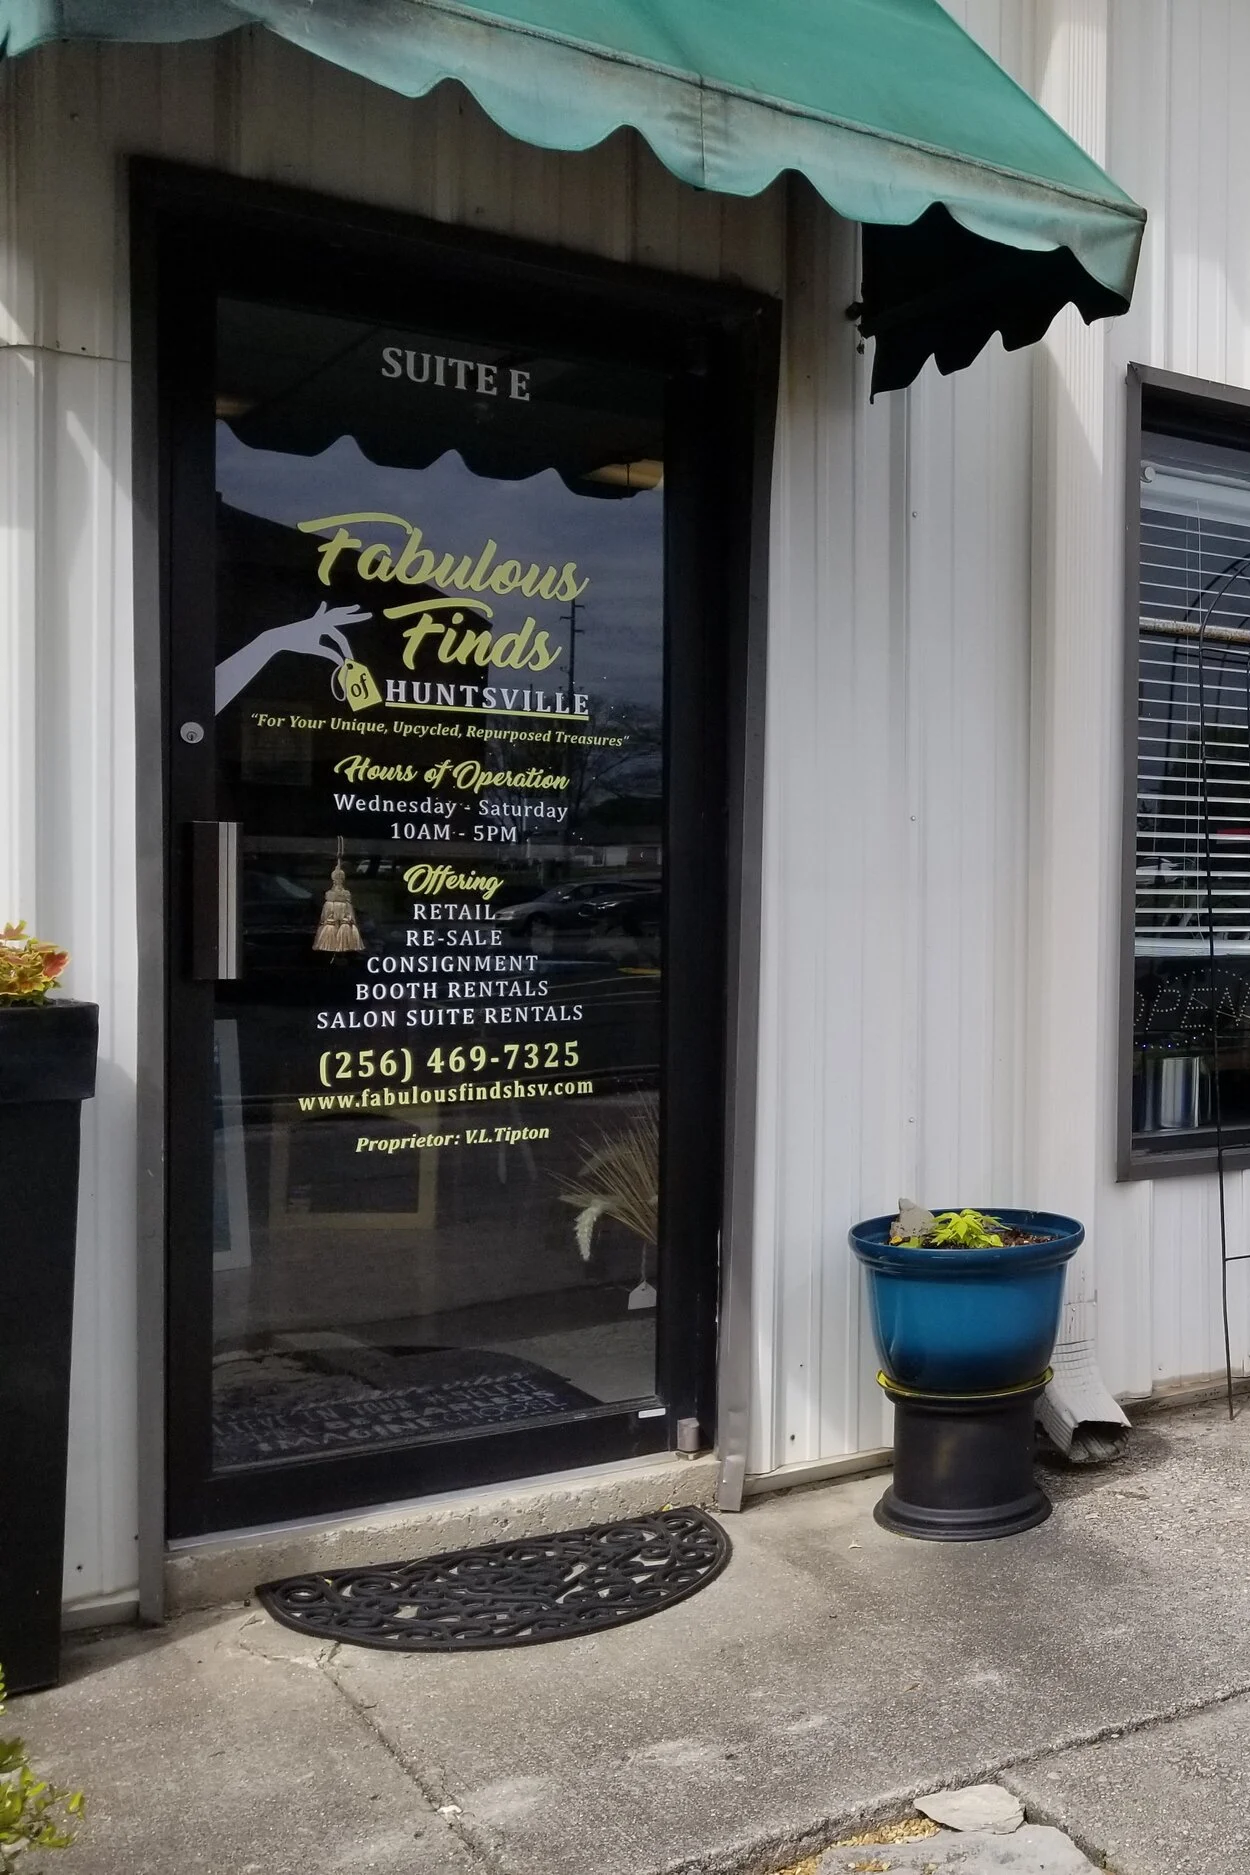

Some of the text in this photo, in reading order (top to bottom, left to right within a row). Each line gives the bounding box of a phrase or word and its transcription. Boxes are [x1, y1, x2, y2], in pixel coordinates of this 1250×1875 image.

[382, 347, 531, 401] SUITE E
[297, 512, 590, 602] Fabulous
[384, 597, 562, 672] Finds
[350, 673, 589, 715] of HUNTSVILLE
[289, 715, 326, 730] Your
[330, 717, 388, 735] Unique,
[393, 721, 462, 739] Upcycled,
[466, 725, 551, 743] Repurposed
[334, 755, 570, 794] Hours of Operation
[334, 793, 457, 818] Wednesday
[478, 799, 568, 822] Saturday
[390, 823, 450, 840] 10AM
[473, 825, 517, 842] 5PM
[403, 864, 504, 900] Offering
[413, 903, 497, 921] RETAIL
[406, 929, 502, 947] RE-SALE
[366, 955, 539, 974] CONSIGNMENT
[355, 980, 549, 1001] BOOTH RENTALS
[317, 1004, 584, 1029] SALON SUITE RENTALS
[319, 1040, 579, 1087] (256) 469-7325
[299, 1079, 594, 1111] www.fabulousfindshsv.com
[355, 1133, 460, 1154] Proprietor:
